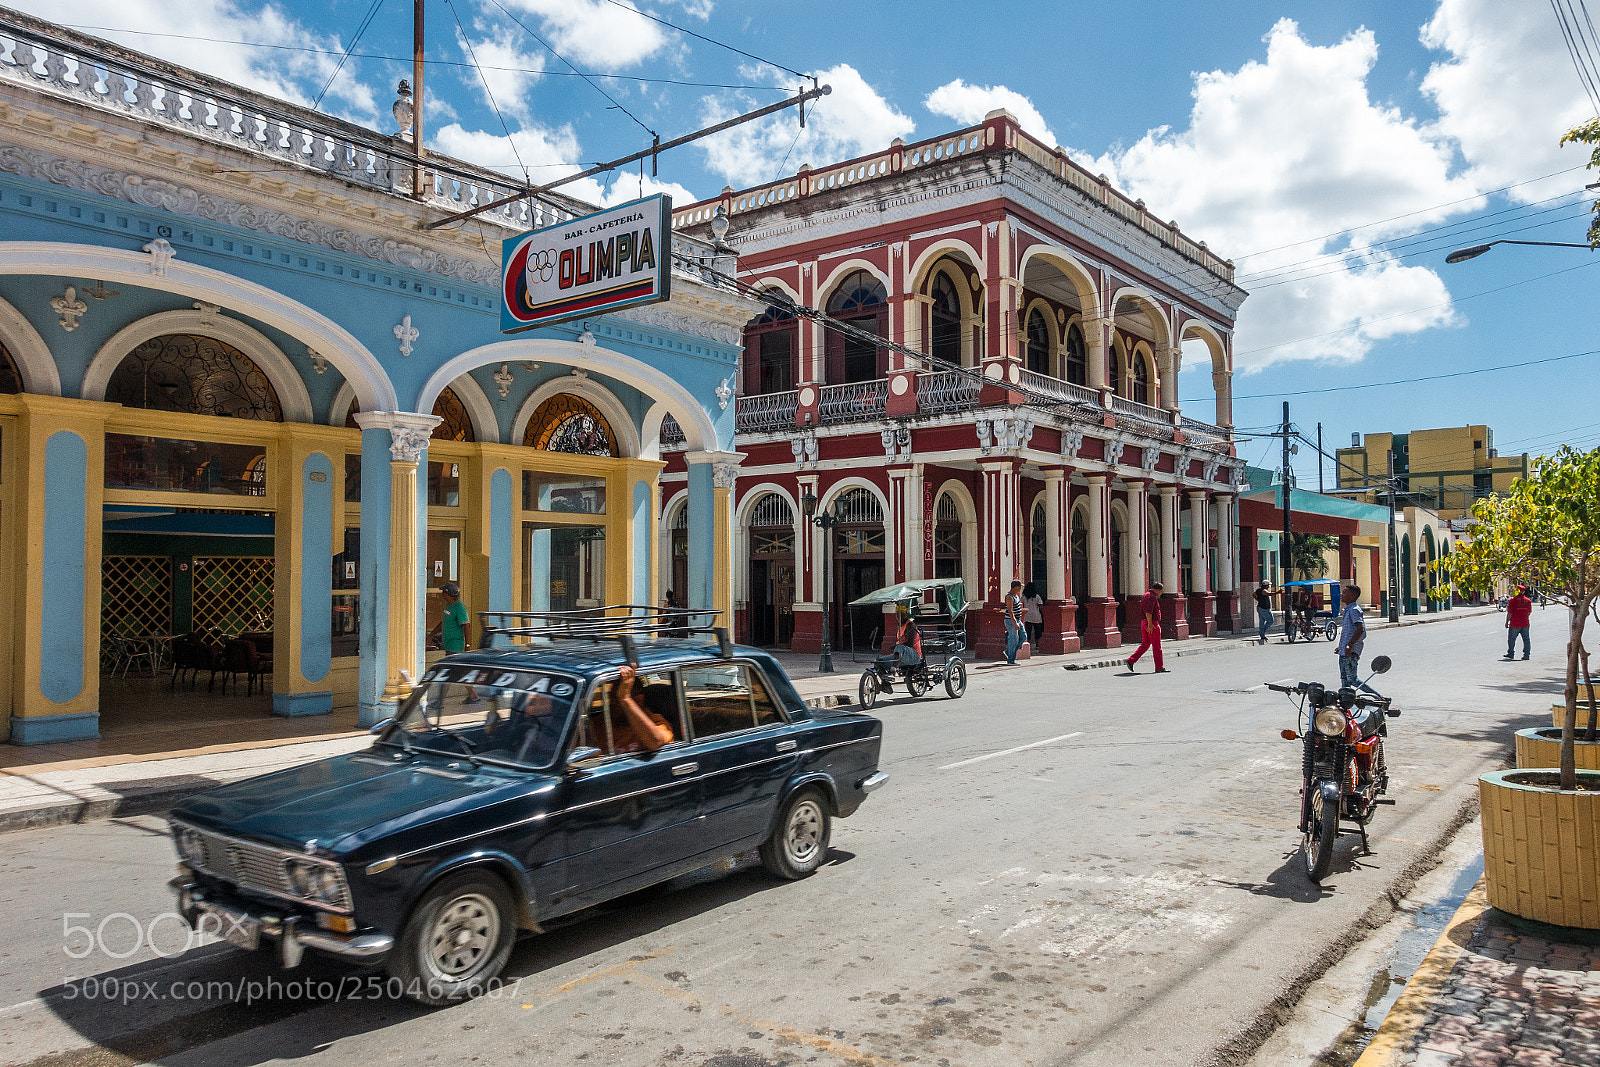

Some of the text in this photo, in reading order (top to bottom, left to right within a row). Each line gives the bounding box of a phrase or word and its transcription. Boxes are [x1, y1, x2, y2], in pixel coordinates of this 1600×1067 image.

[559, 228, 656, 290] OLIMPIA
[923, 481, 933, 561] FARMACIA
[430, 668, 551, 693] LADA
